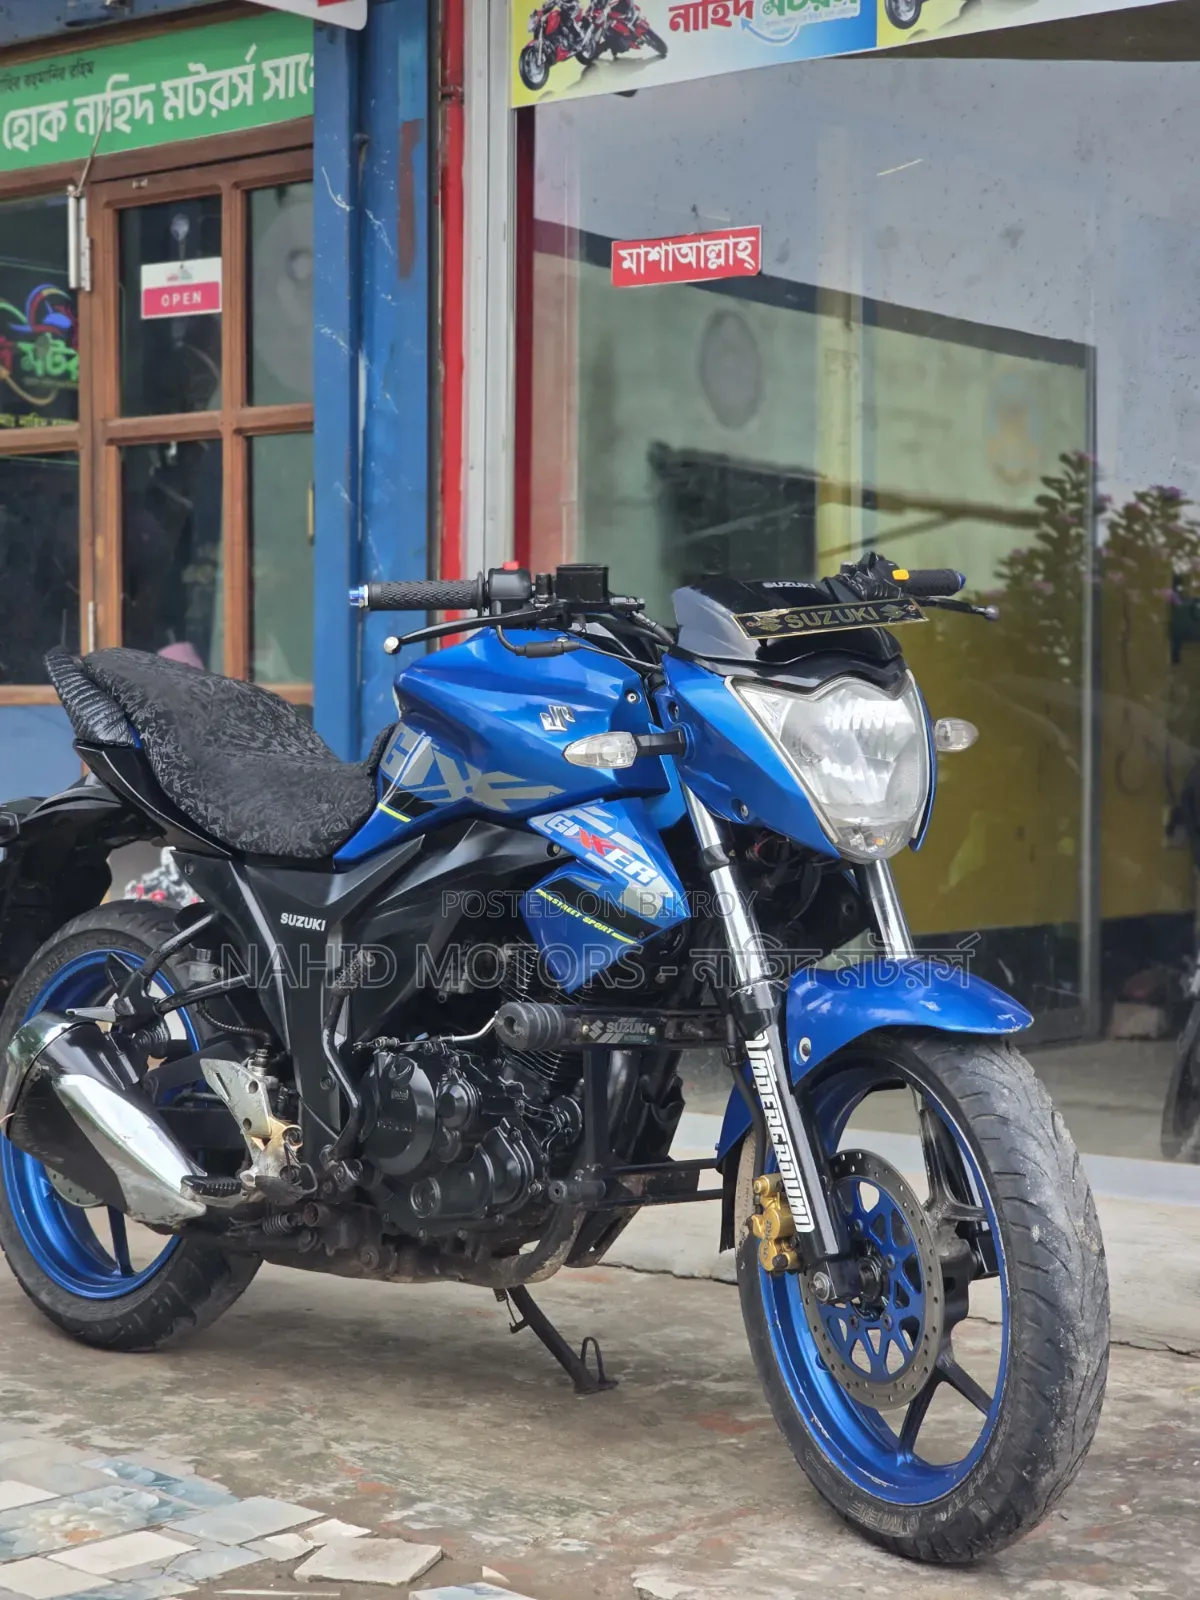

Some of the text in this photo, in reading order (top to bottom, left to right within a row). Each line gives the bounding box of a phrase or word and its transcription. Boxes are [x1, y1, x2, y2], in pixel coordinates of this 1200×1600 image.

[3, 100, 68, 152] হোক
[73, 73, 156, 135] নাহিদ
[161, 290, 202, 308] OPEN
[762, 581, 817, 590] SUZUKI
[783, 606, 880, 629] SUZUKI
[546, 815, 658, 885] GIXXER
[280, 912, 326, 932] SUZUKI
[551, 897, 614, 935] STREET SPORT
[606, 1021, 650, 1034] SUZUKI
[745, 1030, 815, 1232] UNDERGROUND
